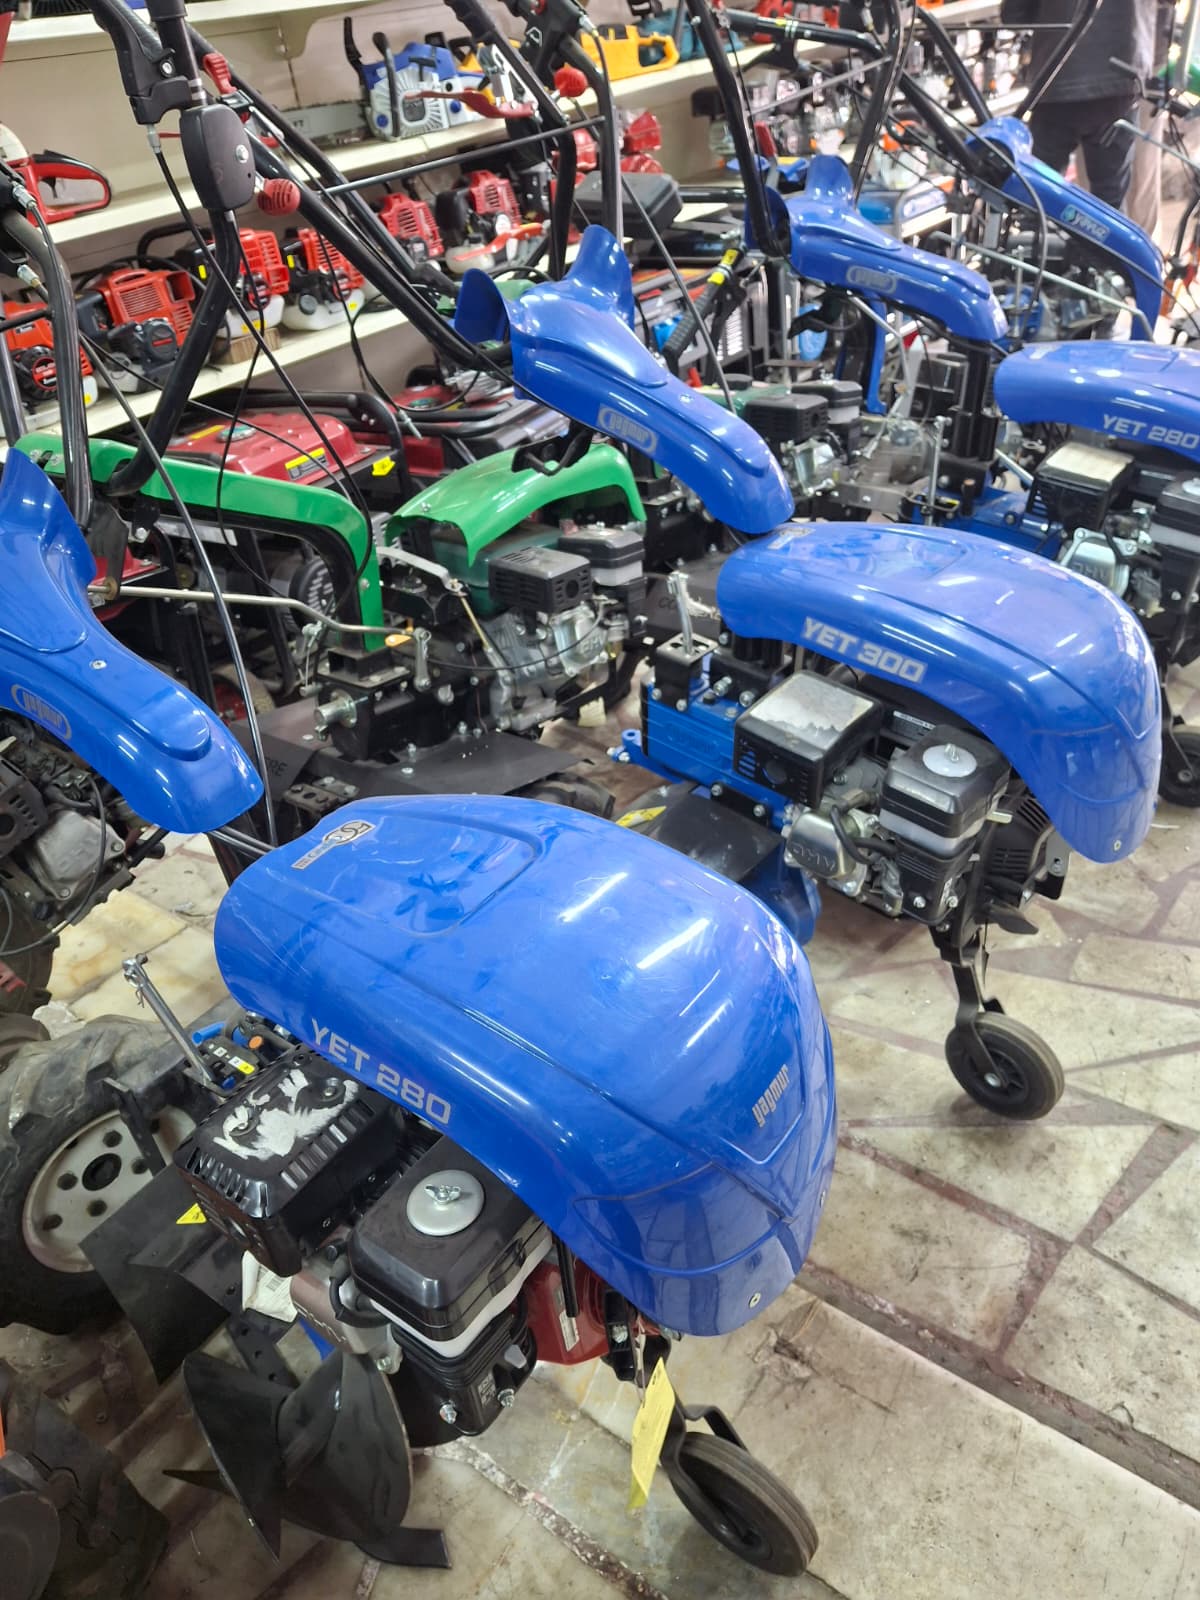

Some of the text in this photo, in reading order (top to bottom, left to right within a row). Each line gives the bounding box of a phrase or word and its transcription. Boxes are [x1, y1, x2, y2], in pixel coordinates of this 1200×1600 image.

[1103, 413, 1200, 449] YET 280
[803, 615, 925, 683] YET 300
[311, 1017, 452, 1125] YET 280
